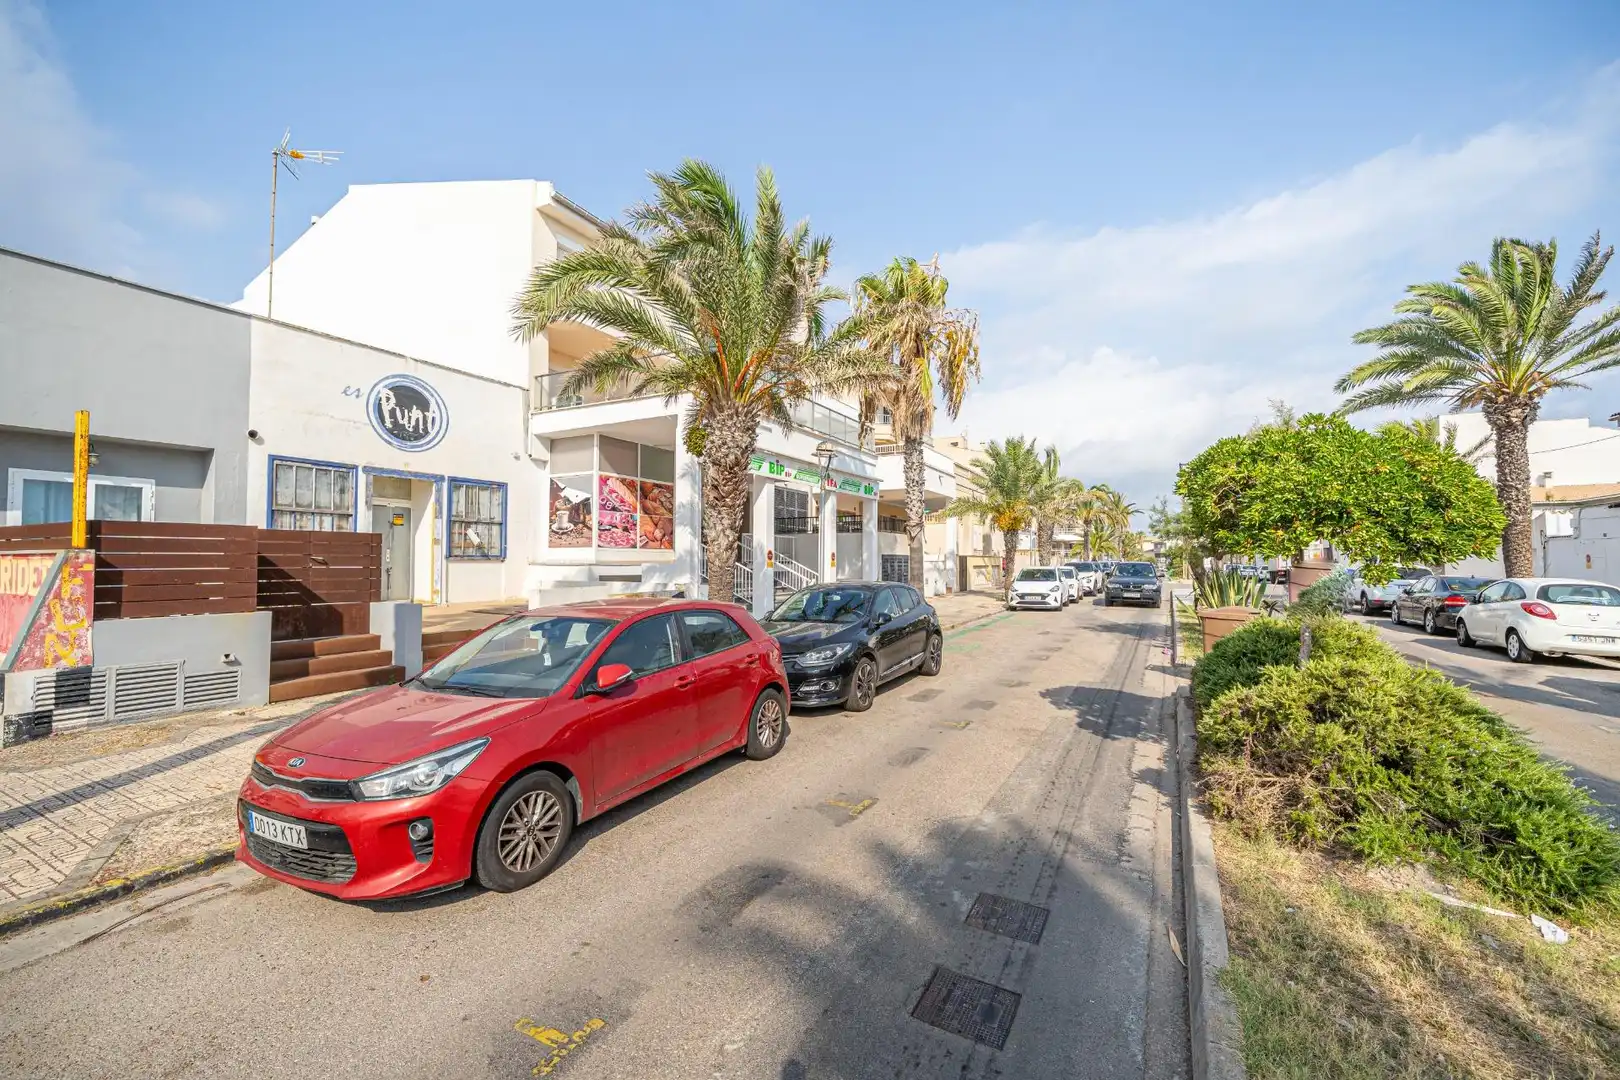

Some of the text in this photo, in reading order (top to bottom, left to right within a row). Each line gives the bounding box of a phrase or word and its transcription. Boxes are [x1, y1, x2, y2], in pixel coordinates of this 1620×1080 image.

[341, 385, 363, 399] es
[254, 816, 304, 846] 0013 KTX
